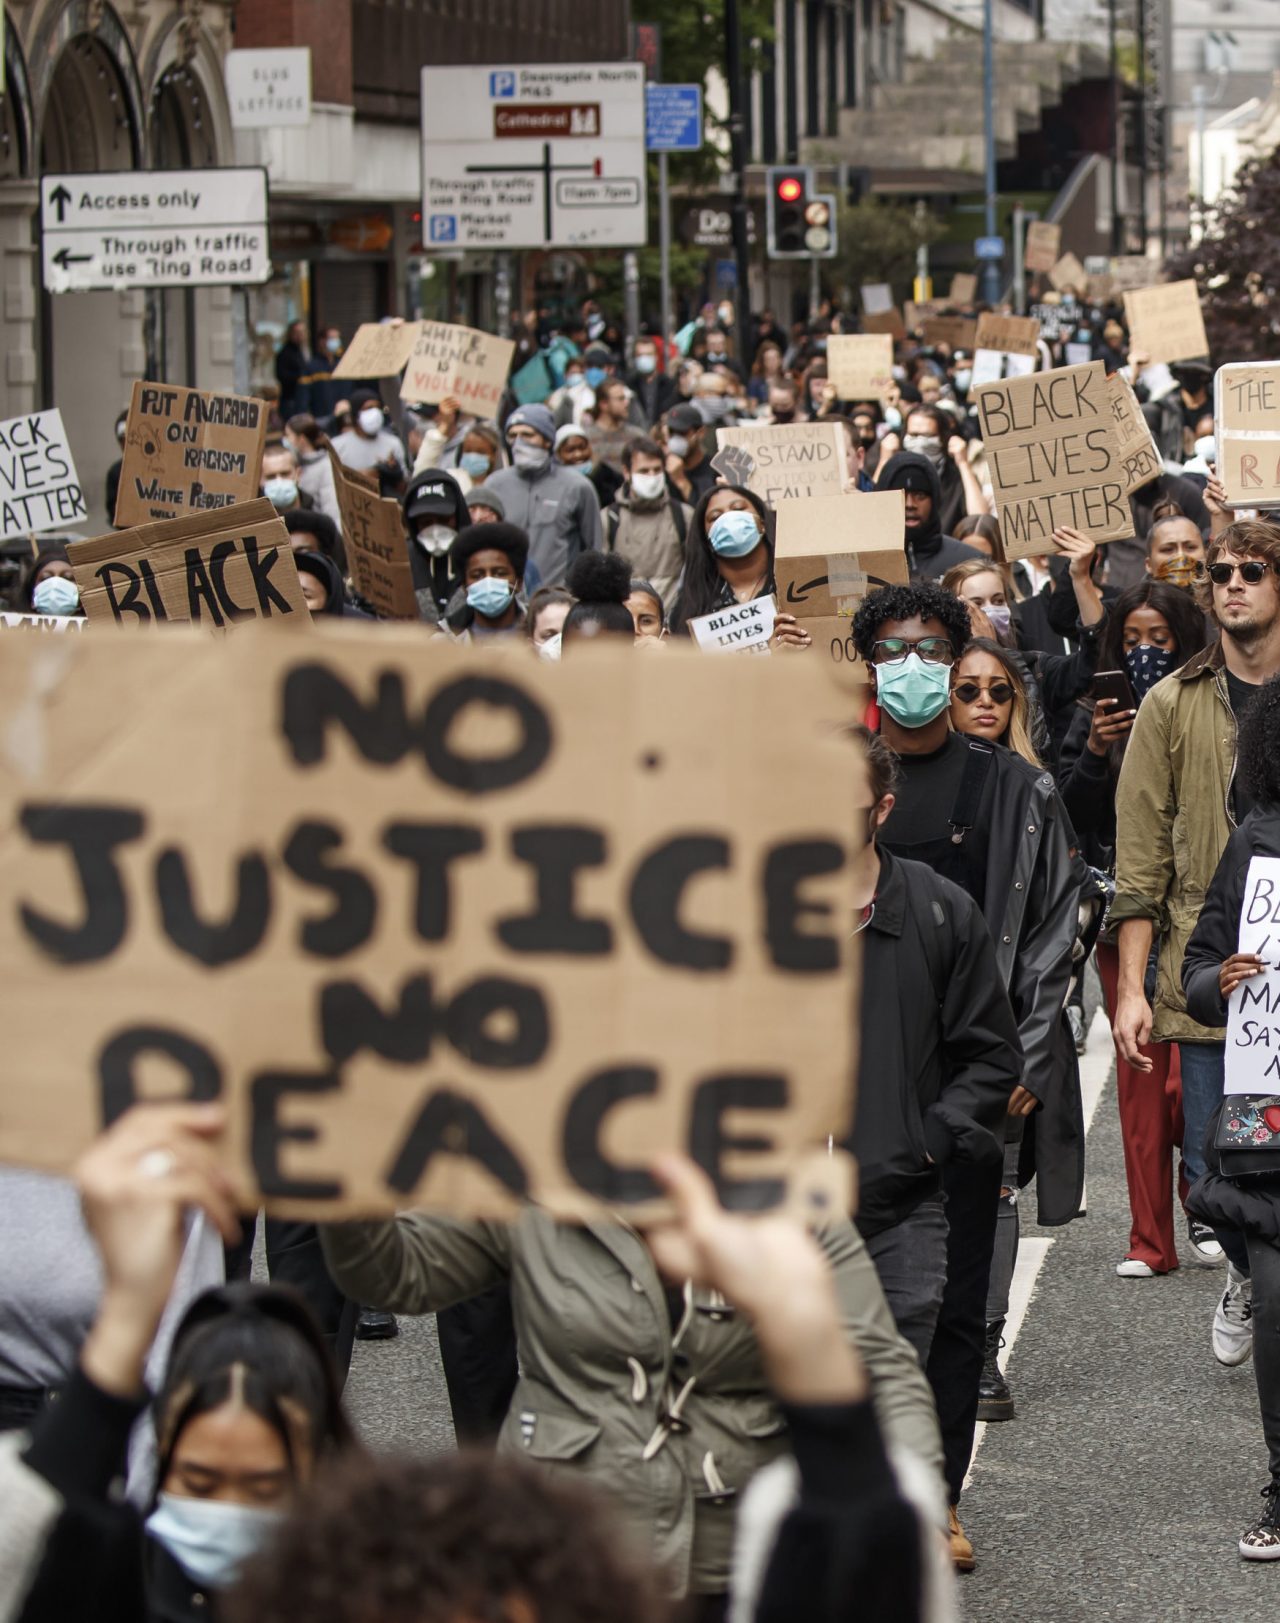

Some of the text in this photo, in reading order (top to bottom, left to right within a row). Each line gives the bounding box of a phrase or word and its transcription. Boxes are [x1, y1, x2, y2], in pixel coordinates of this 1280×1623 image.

[520, 70, 592, 86] Deansgate
[599, 69, 638, 83] North
[497, 110, 568, 129] Cathedral
[429, 178, 486, 193] Through
[499, 191, 533, 204] Road
[80, 190, 201, 210] Access only
[460, 213, 511, 225] Market
[101, 233, 259, 256] Through traffic
[466, 227, 505, 240] Place
[102, 263, 137, 278] use
[200, 257, 253, 275] Road
[420, 323, 483, 349] WHITE
[414, 341, 488, 368] SILENCE
[436, 360, 450, 373] IS
[414, 371, 500, 402] VIOLENCE
[140, 388, 178, 417] PUT
[981, 369, 1098, 438] BLACK
[166, 422, 198, 443] ON
[184, 447, 247, 475] RACISM
[756, 442, 832, 467] STAND
[994, 428, 1111, 490] LIVES
[1003, 483, 1127, 548] MATTER
[94, 535, 294, 630] BLACK
[708, 604, 763, 632] BLACK
[717, 622, 764, 647] LIVES
[277, 660, 556, 795] NO
[15, 802, 851, 976] JUSTICE
[315, 967, 555, 1072] NO
[97, 1020, 793, 1212] PEACE
